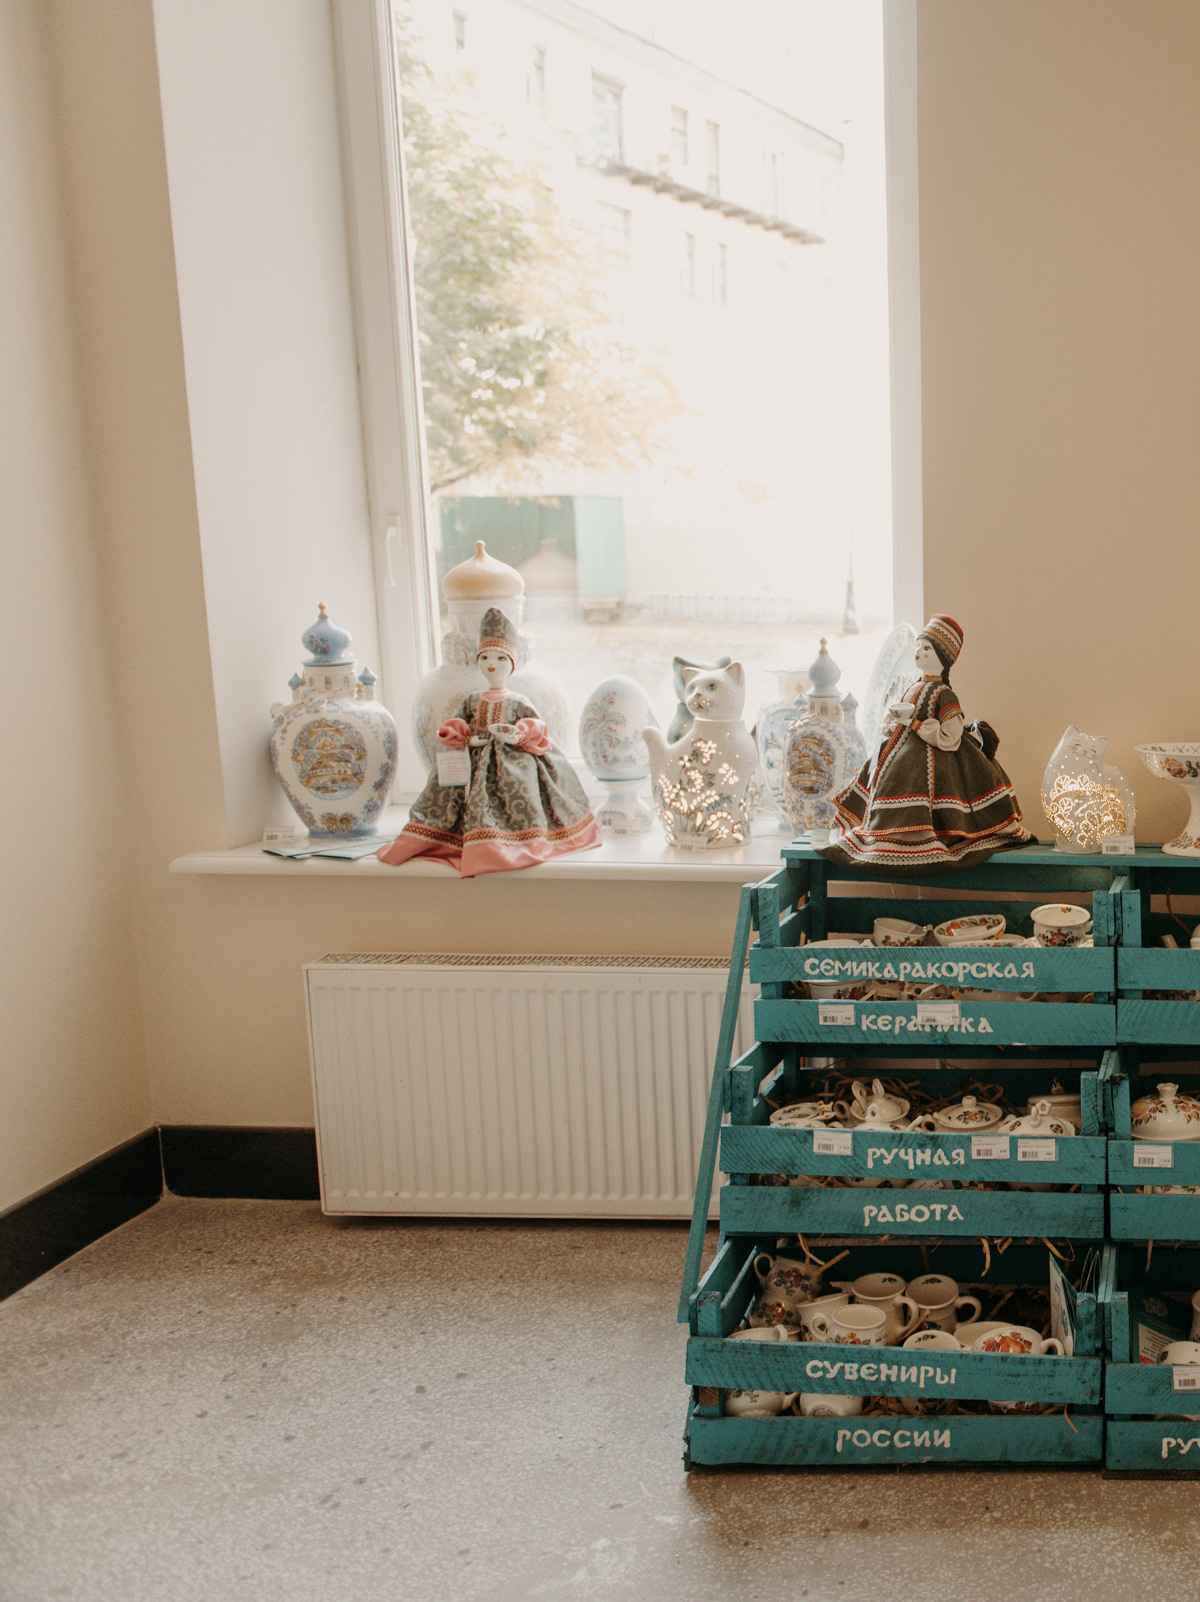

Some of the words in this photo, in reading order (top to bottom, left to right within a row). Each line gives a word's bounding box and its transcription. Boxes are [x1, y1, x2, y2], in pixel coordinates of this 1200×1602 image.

[803, 957, 1035, 982] СЕМИКАРАКОРСКАЯ
[866, 1148, 966, 1170] РУЧНАЯ
[863, 1203, 964, 1226] РАБОТА
[805, 1359, 957, 1388] СУВЕНИРЫ
[836, 1429, 952, 1452] РОССИИ
